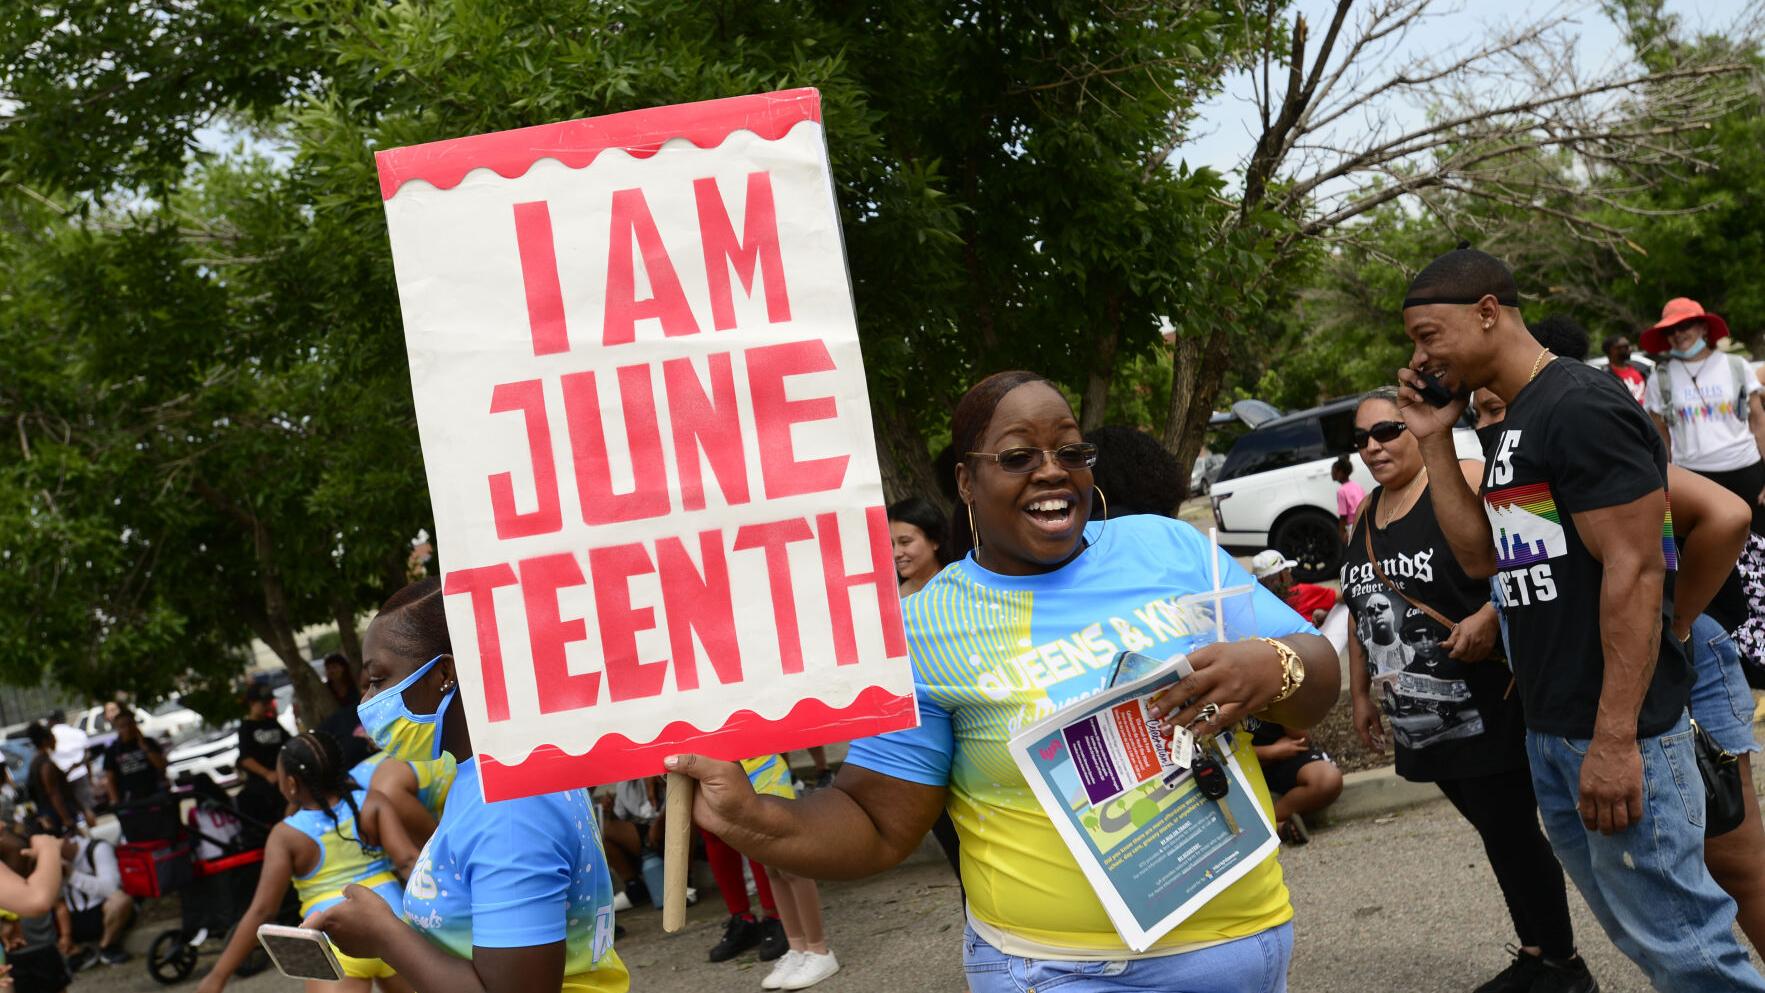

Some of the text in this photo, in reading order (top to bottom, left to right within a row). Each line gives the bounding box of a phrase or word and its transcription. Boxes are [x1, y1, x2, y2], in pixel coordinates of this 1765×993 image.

[513, 171, 792, 356] I AM
[487, 338, 851, 540] JUNE
[443, 505, 908, 723] TEENTH
[1340, 547, 1434, 593] Legnds
[1351, 582, 1384, 598] Never
[977, 622, 1114, 700] QUEENS
[1108, 616, 1154, 653] &
